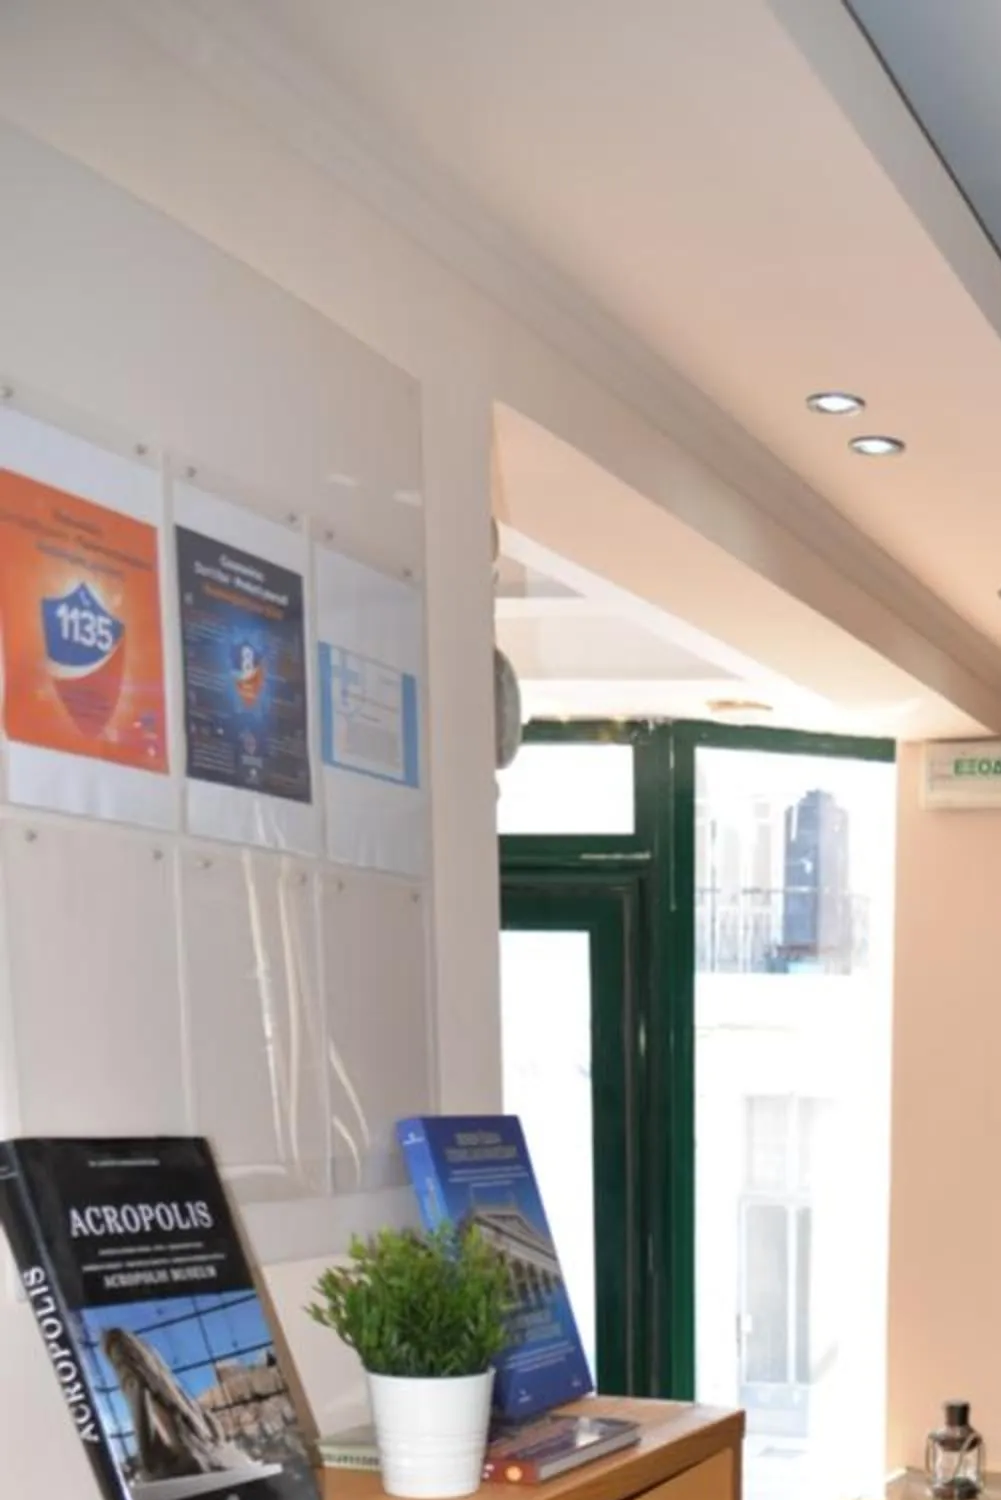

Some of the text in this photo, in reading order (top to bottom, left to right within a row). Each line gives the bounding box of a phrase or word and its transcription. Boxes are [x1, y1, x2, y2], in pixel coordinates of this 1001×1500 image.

[55, 604, 114, 652] 1135
[69, 1200, 214, 1238] ACROPOLIS
[22, 1265, 100, 1444] ACROPOLIS
